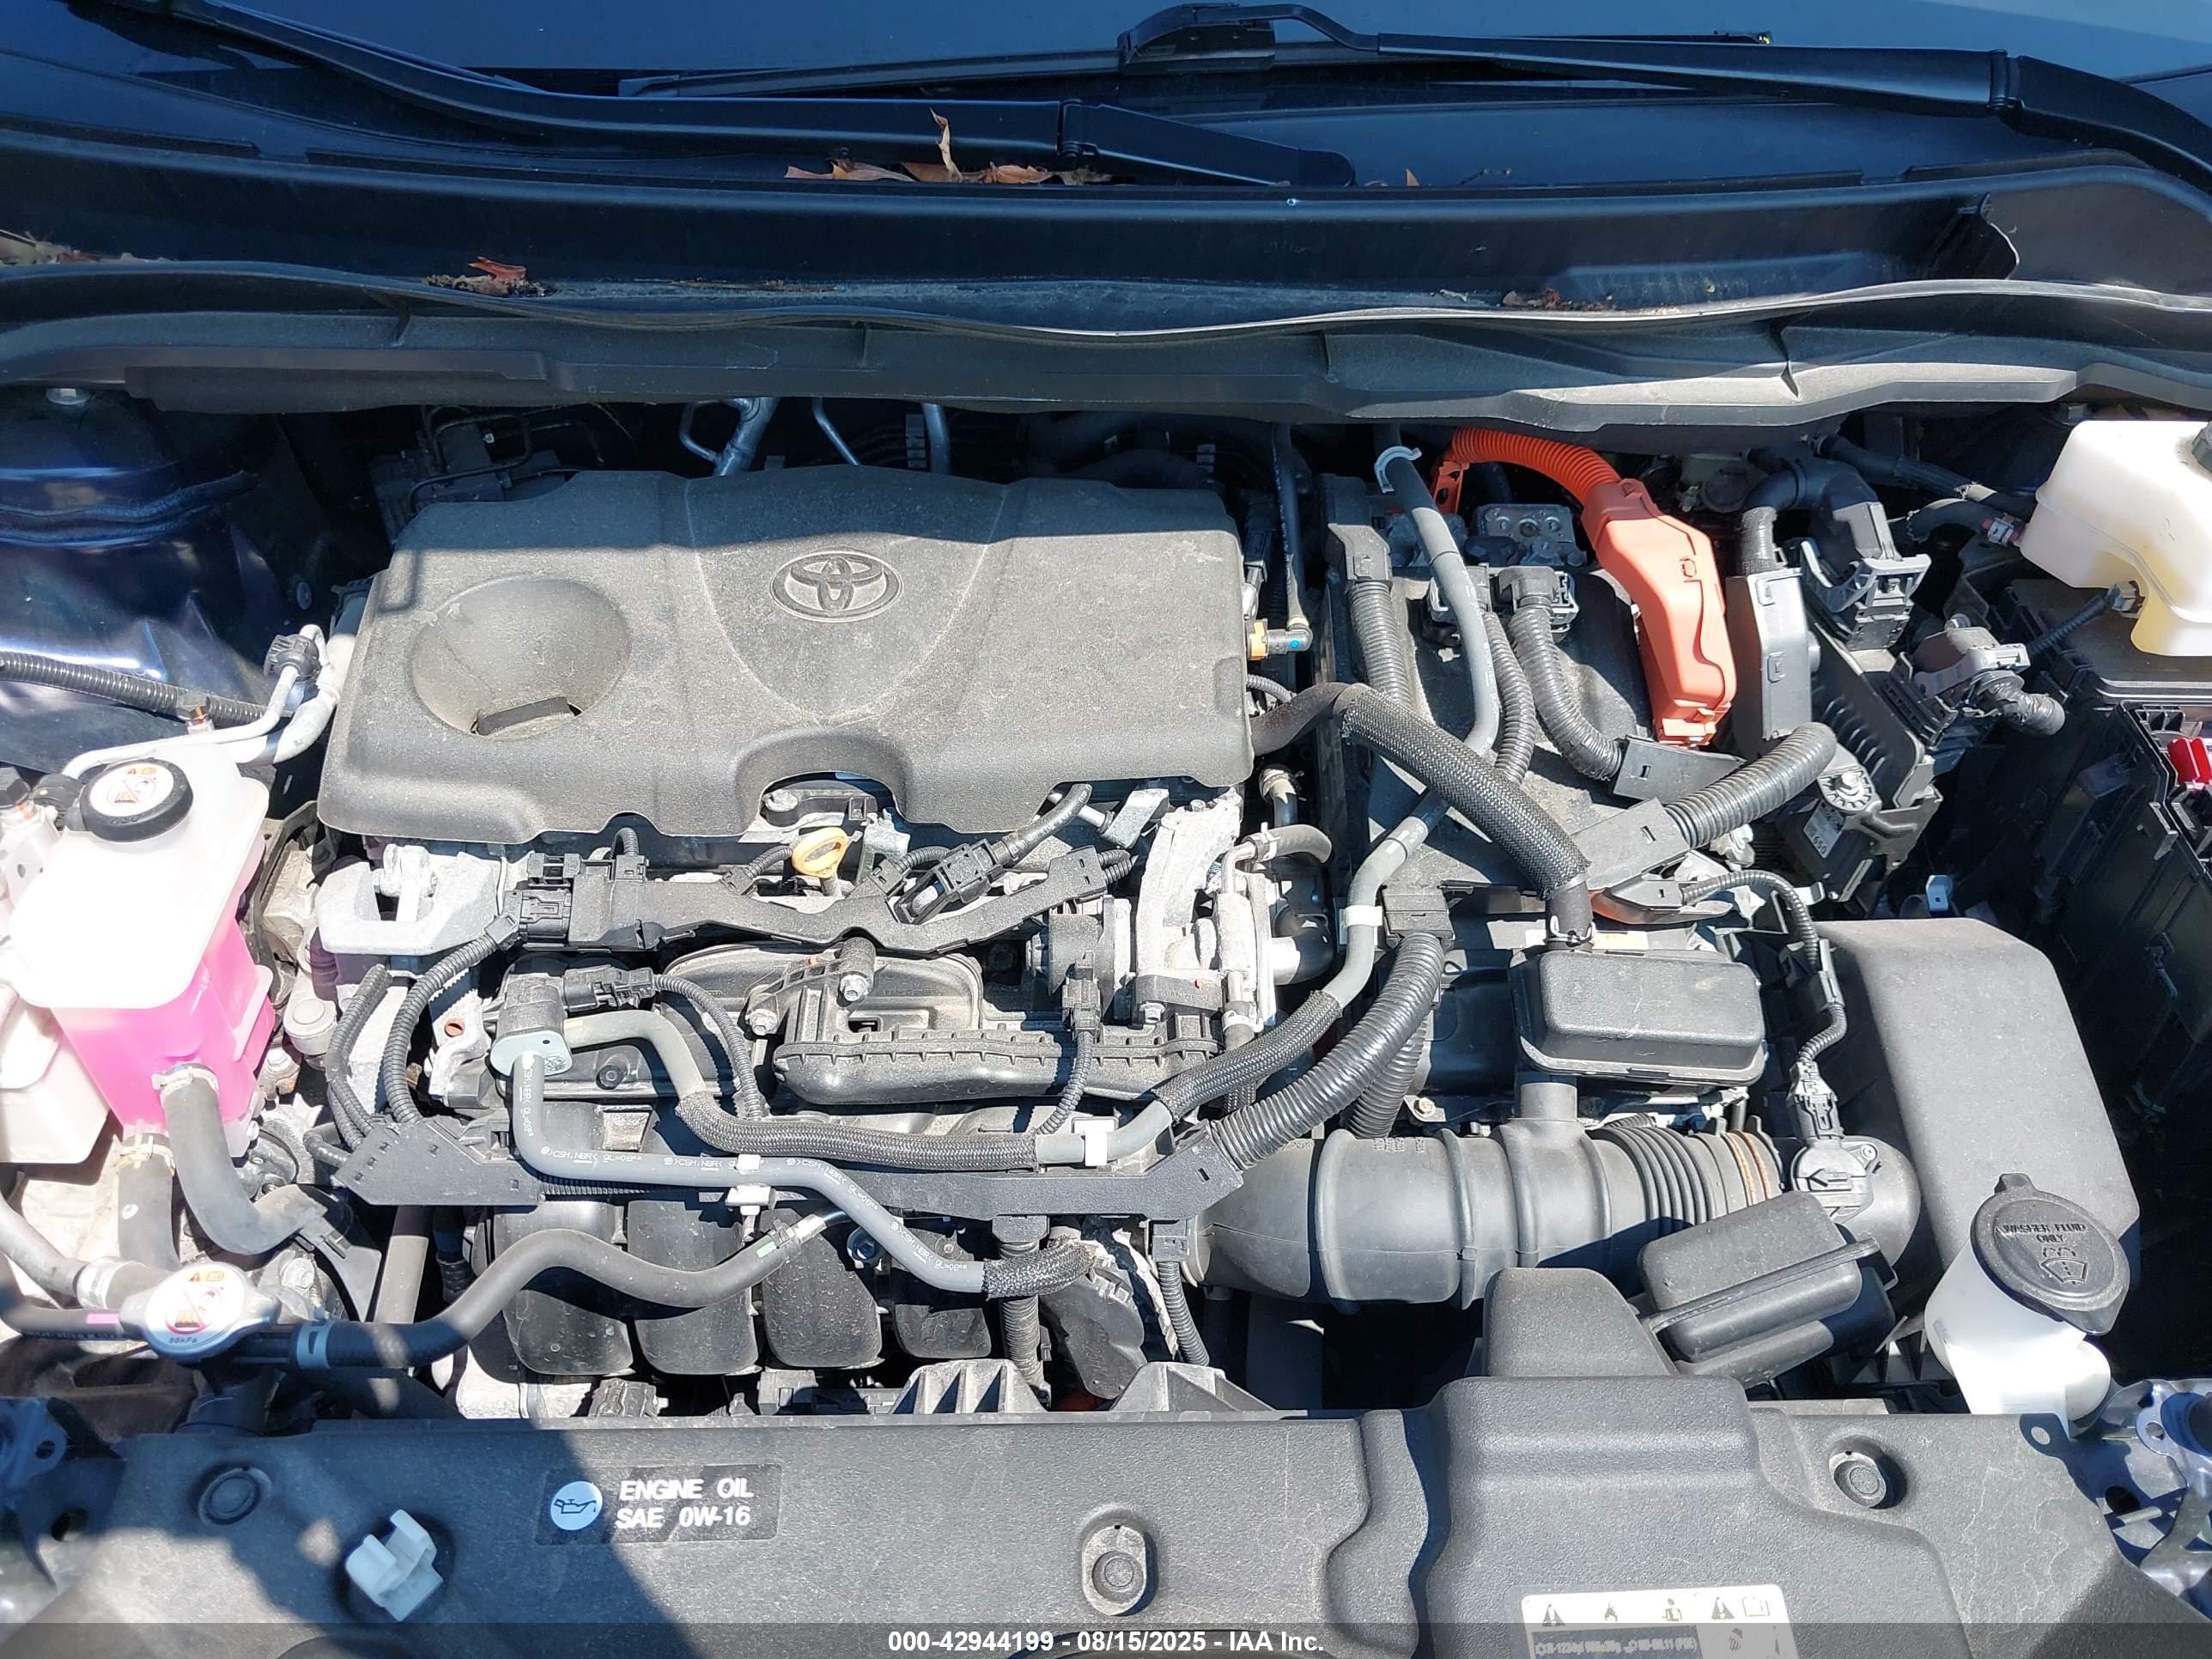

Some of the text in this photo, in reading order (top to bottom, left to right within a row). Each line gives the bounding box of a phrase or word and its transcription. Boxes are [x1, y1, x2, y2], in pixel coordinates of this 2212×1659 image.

[2002, 1222, 2087, 1233] WASHER FLUID
[2035, 1234, 2064, 1243] ONLY
[618, 1477, 755, 1501] ENGINE OIL
[615, 1505, 751, 1528] SAE 0W-16
